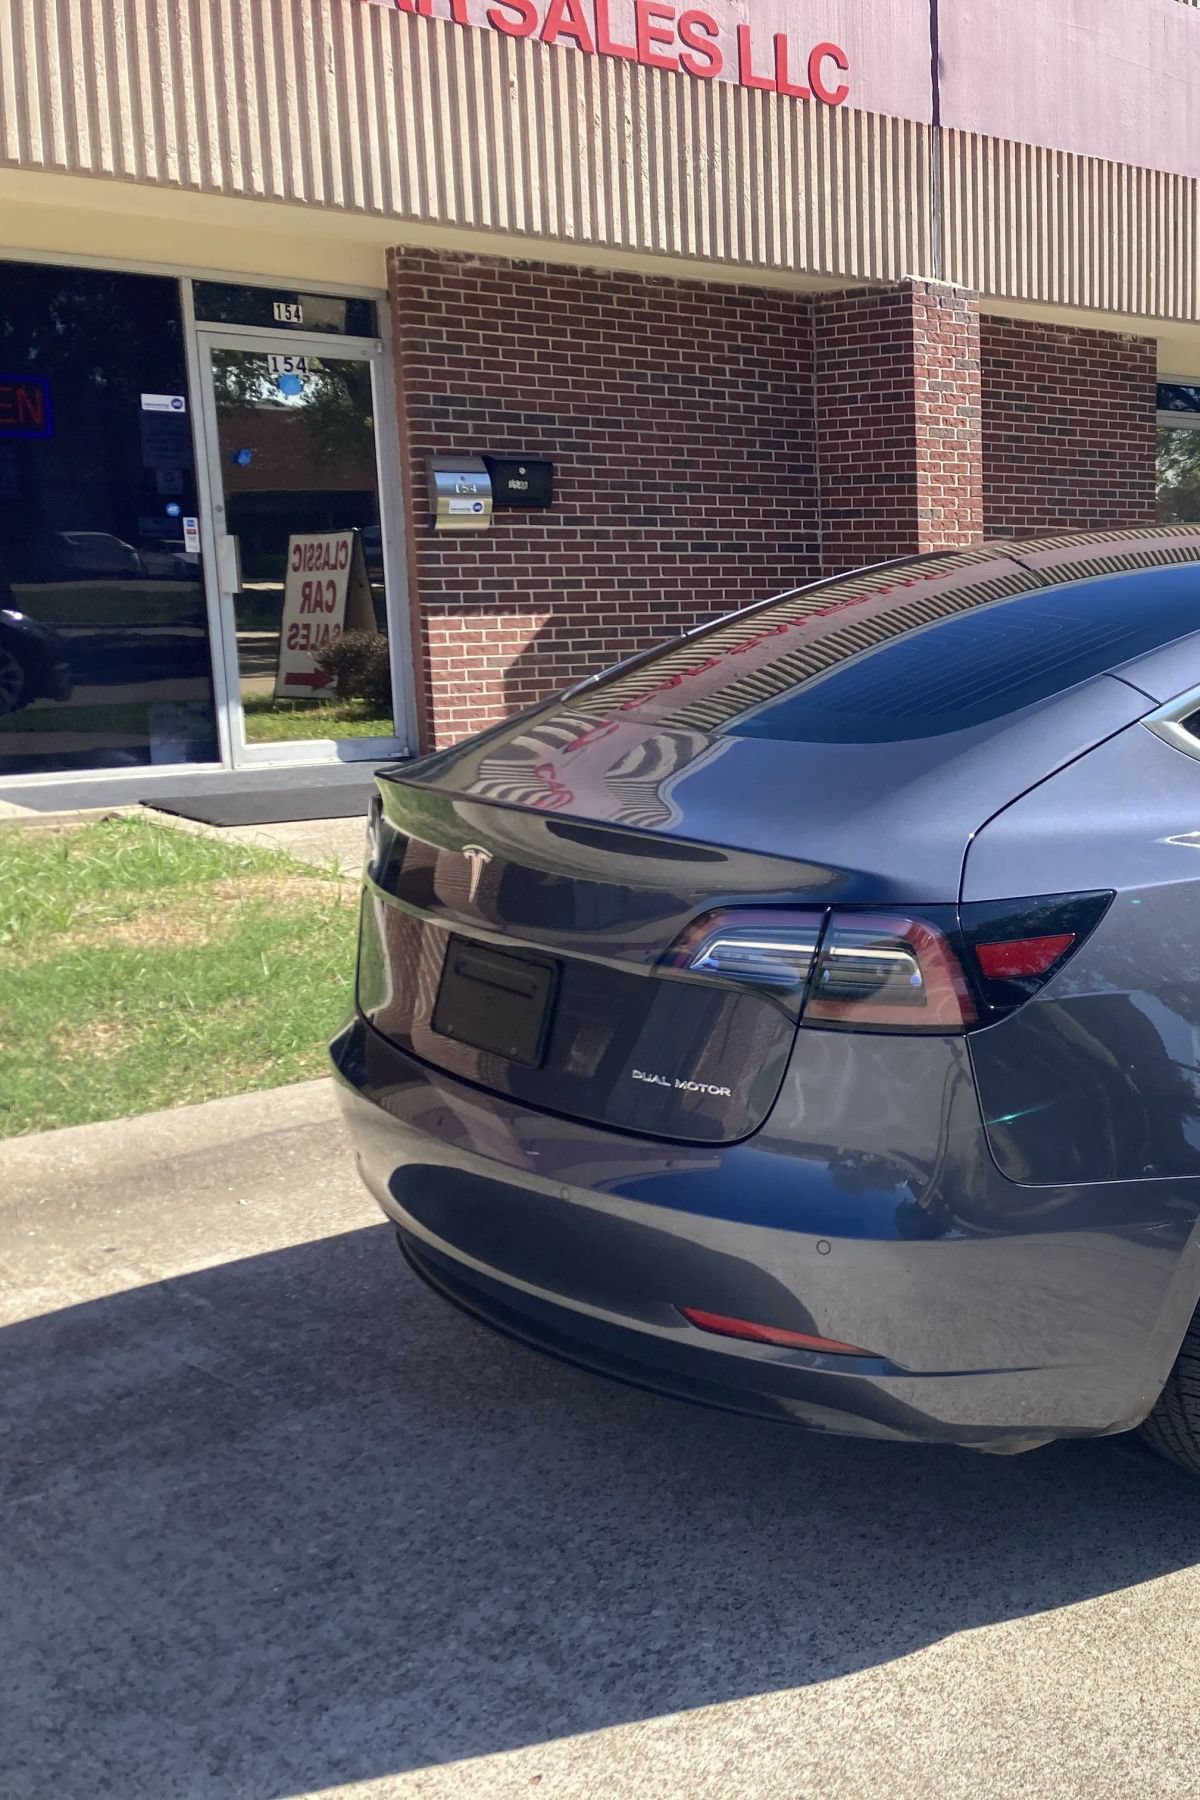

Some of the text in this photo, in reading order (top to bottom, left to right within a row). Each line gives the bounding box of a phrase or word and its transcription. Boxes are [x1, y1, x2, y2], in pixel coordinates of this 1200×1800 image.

[484, 0, 850, 106] SALES LLC
[276, 303, 301, 322] 154
[271, 356, 307, 374] 154
[631, 1068, 731, 1097] DUAL MOTOR
